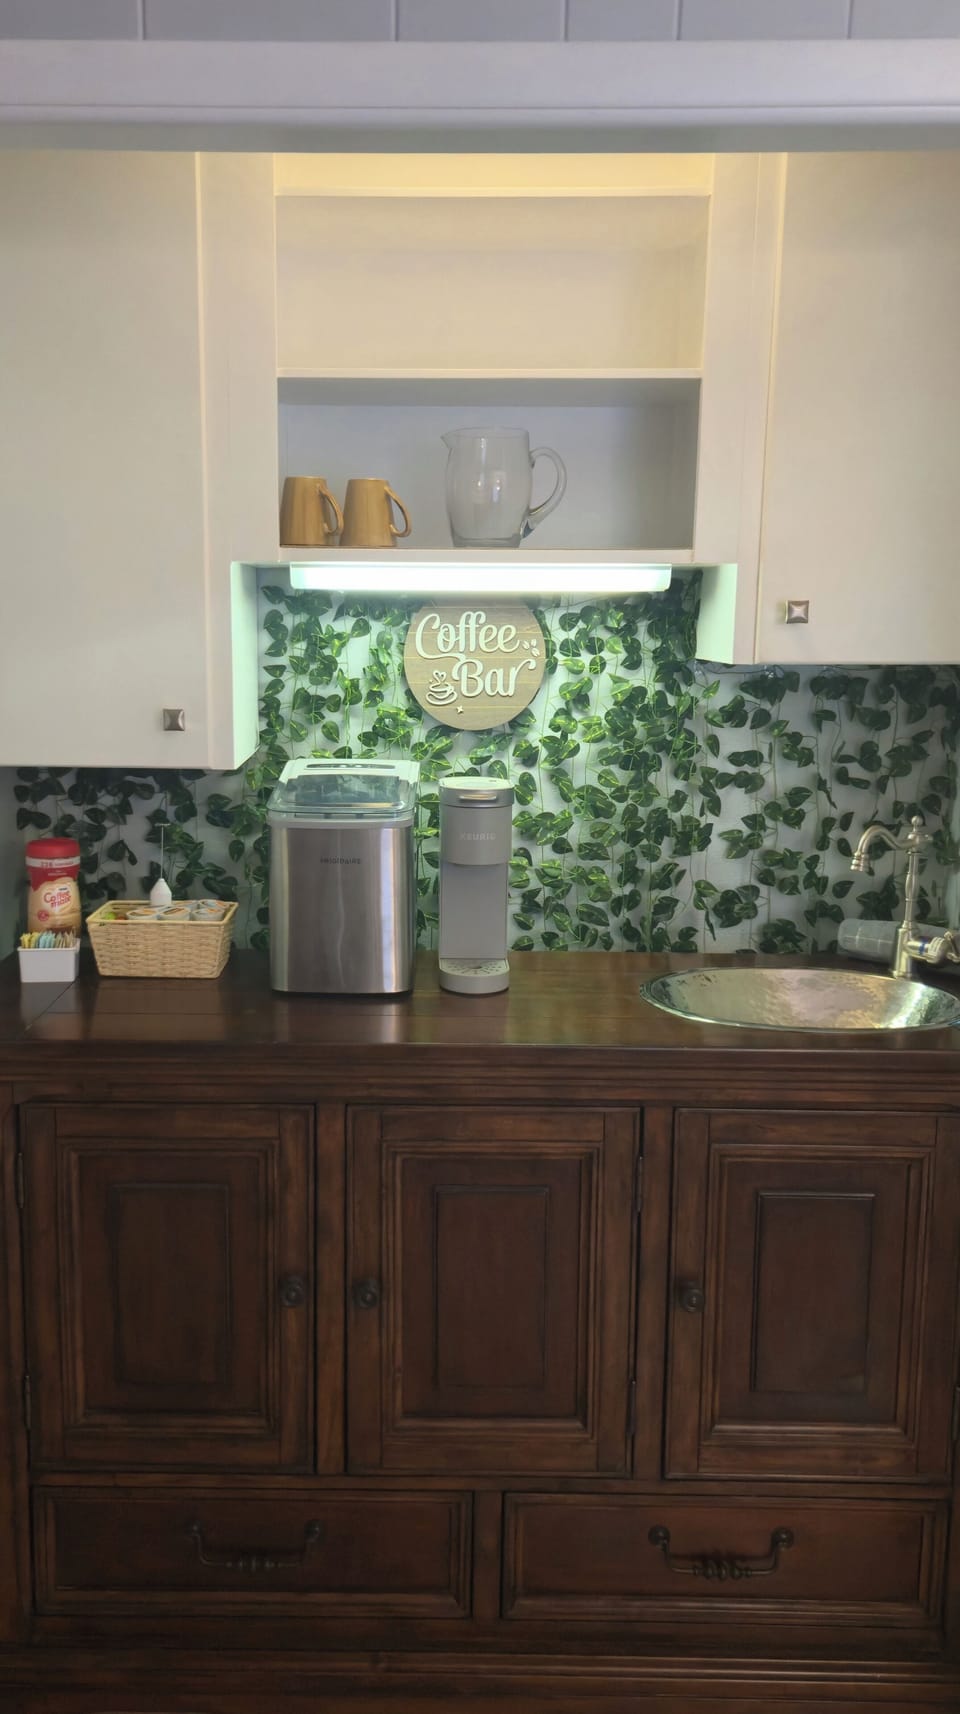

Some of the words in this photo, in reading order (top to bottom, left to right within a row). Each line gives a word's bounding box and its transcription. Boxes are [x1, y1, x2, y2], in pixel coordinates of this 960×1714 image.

[415, 611, 520, 659] Coffee
[452, 658, 537, 697] Bar
[459, 831, 497, 841] KEURIG
